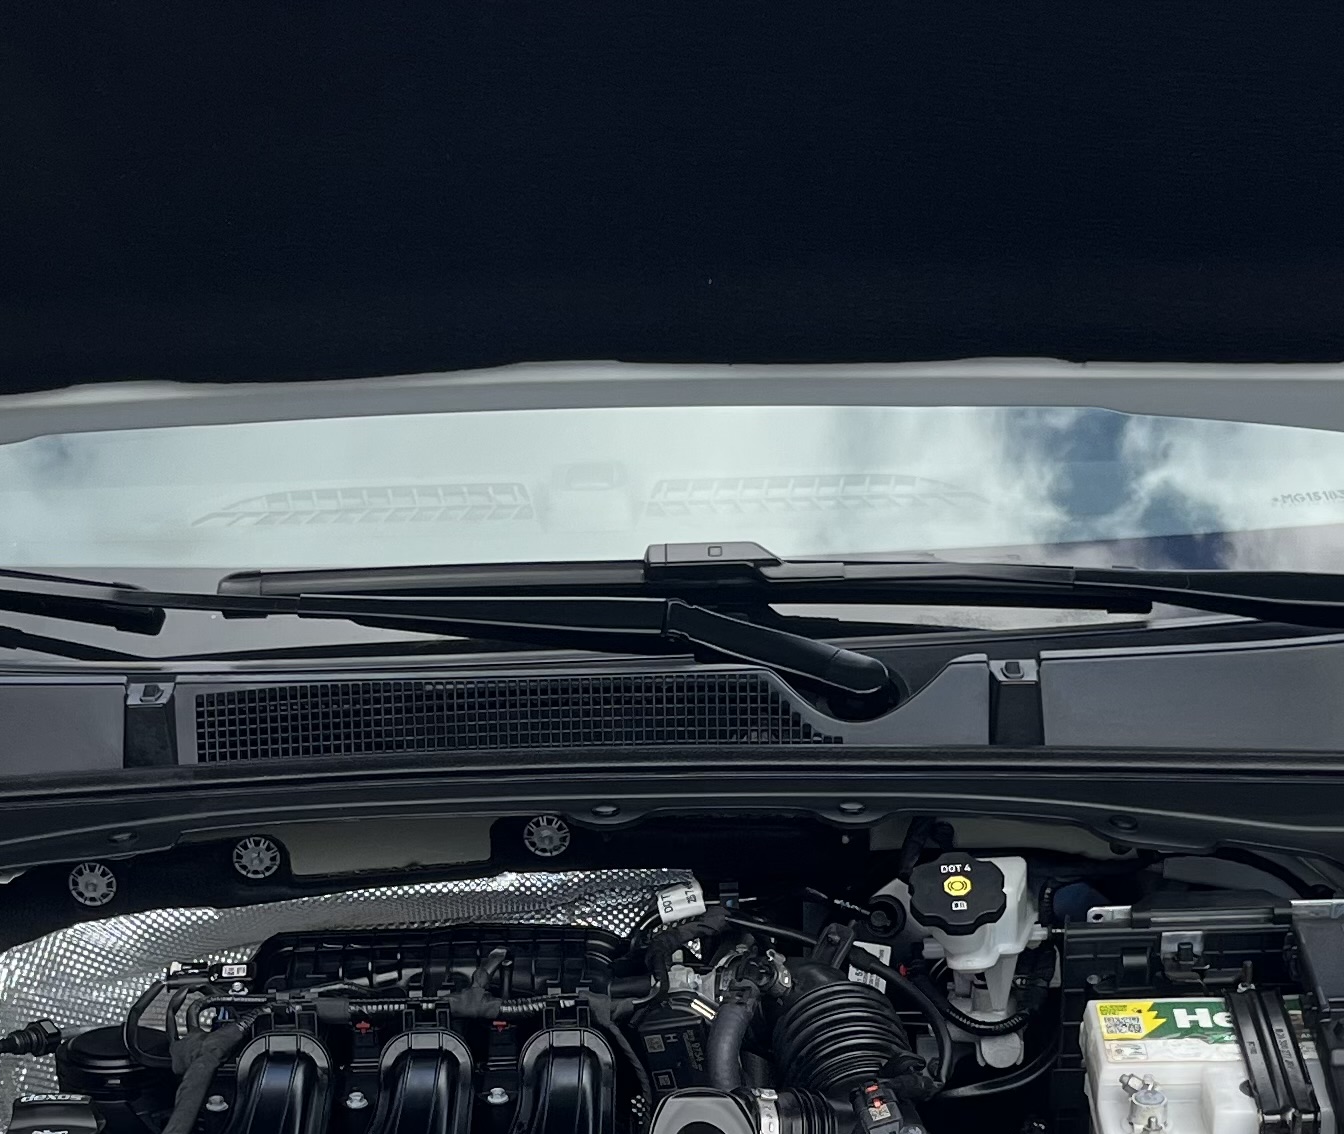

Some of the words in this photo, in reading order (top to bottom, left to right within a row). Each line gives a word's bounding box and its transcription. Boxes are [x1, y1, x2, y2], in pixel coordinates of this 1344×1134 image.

[940, 864, 962, 874] DOT
[963, 863, 972, 872] 4
[20, 1094, 84, 1103] dexos
